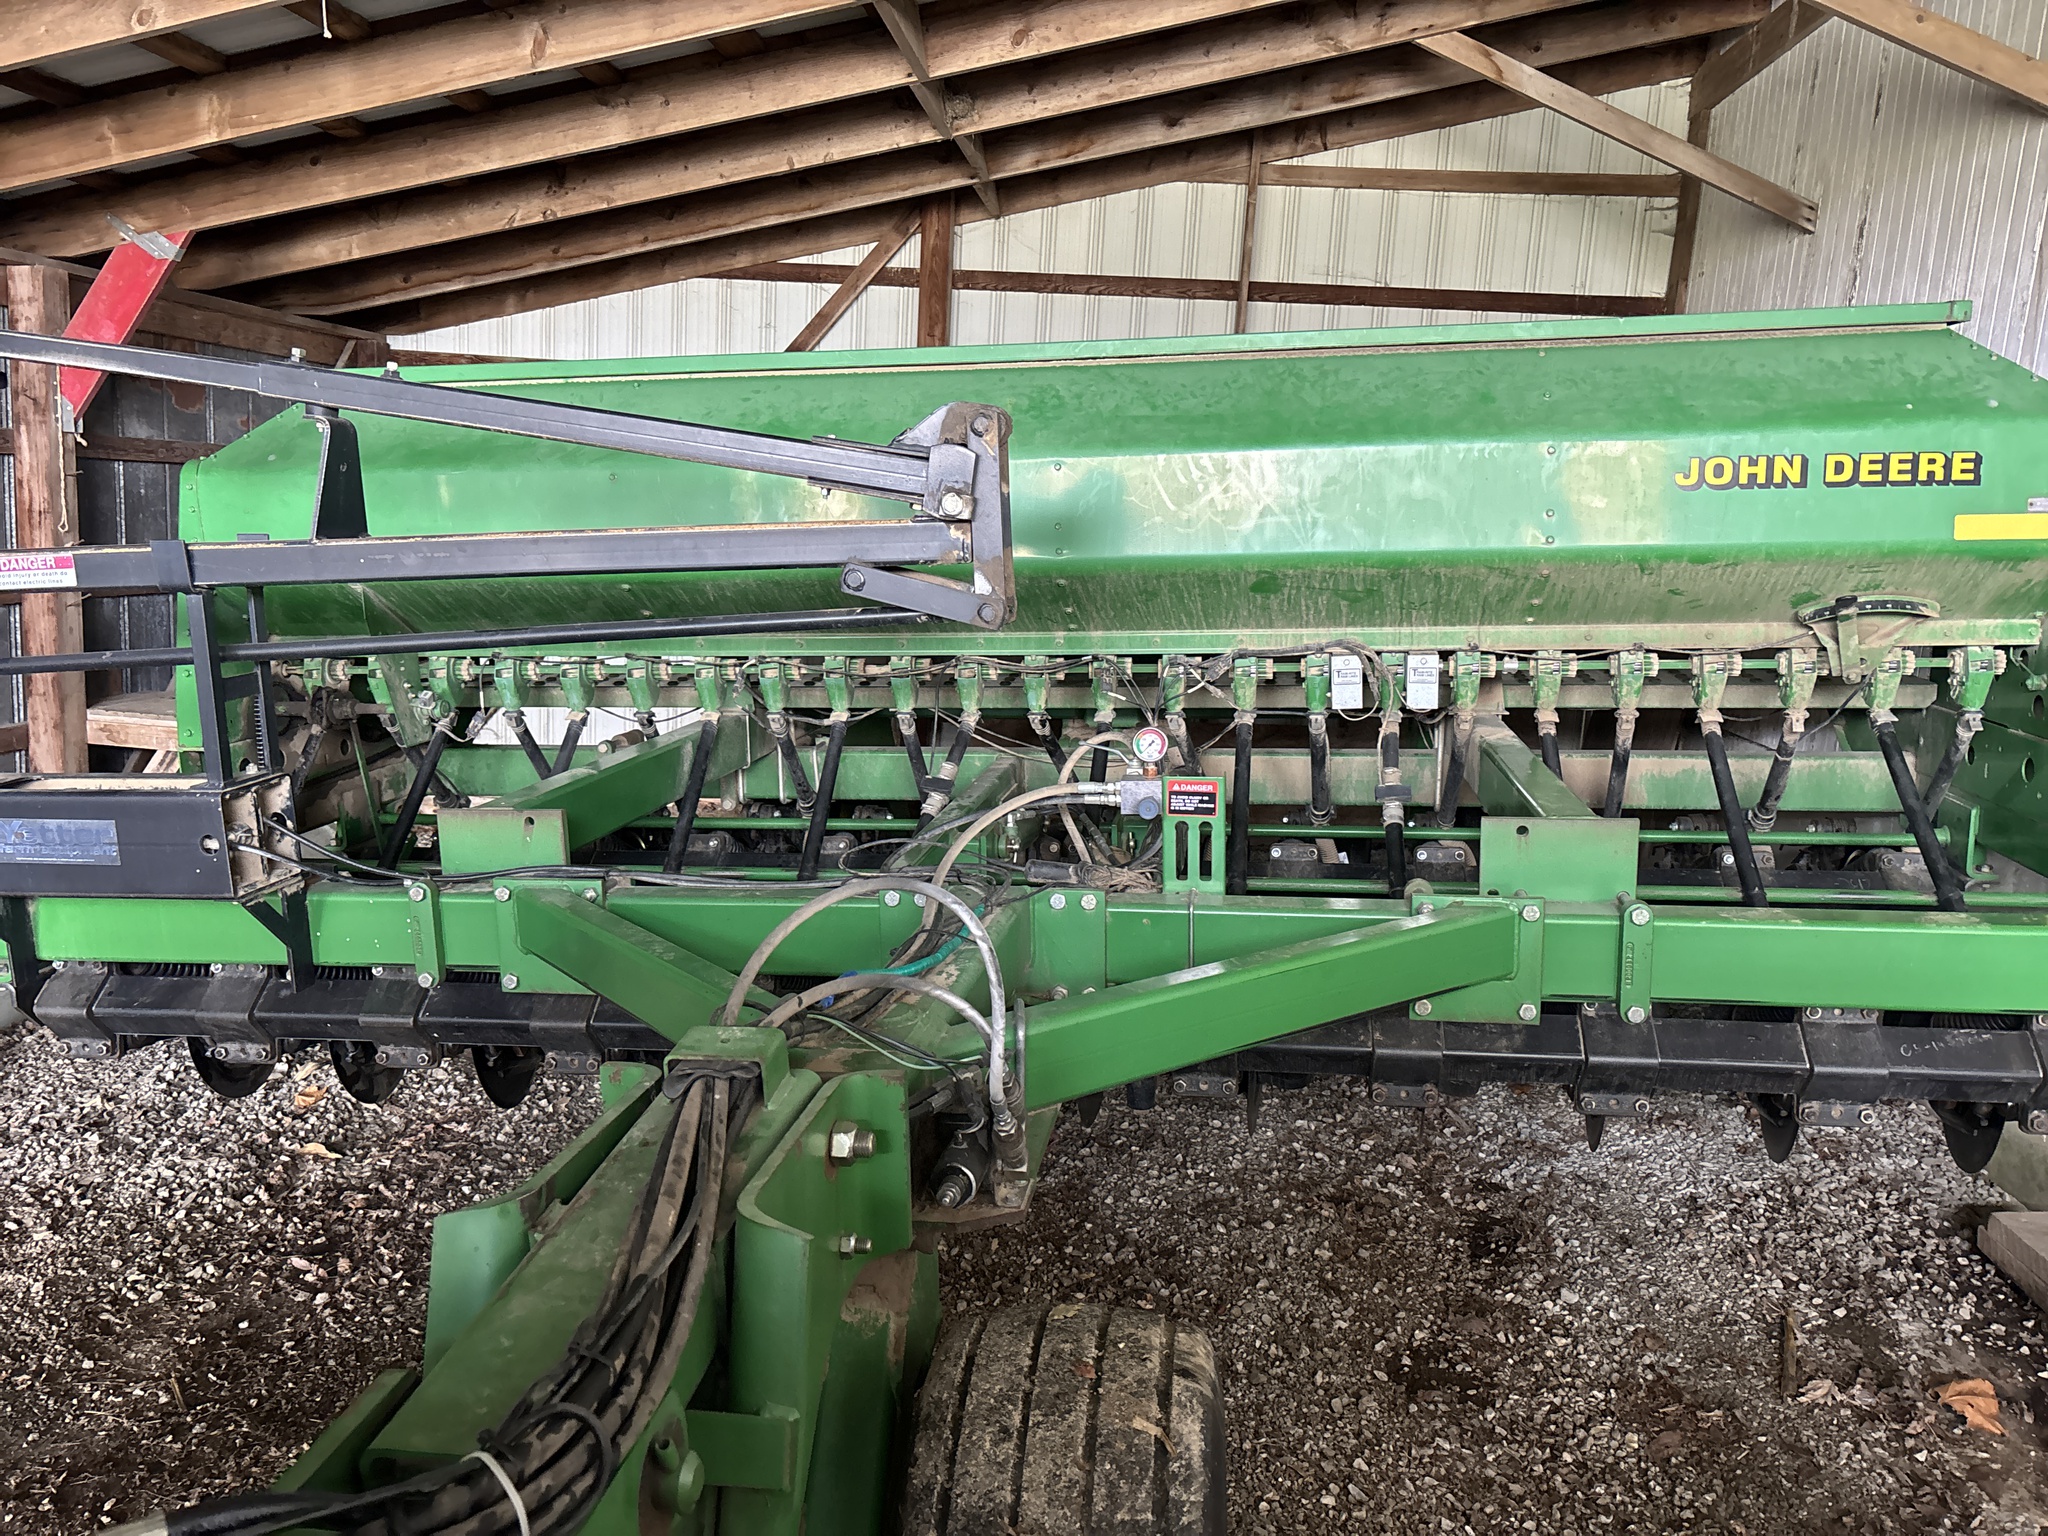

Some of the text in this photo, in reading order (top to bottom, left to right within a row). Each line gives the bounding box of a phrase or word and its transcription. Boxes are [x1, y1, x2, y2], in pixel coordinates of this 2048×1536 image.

[1674, 450, 1983, 491] JOHN DEERE
[0, 556, 56, 570] DANGER
[1180, 784, 1213, 792] DANGER
